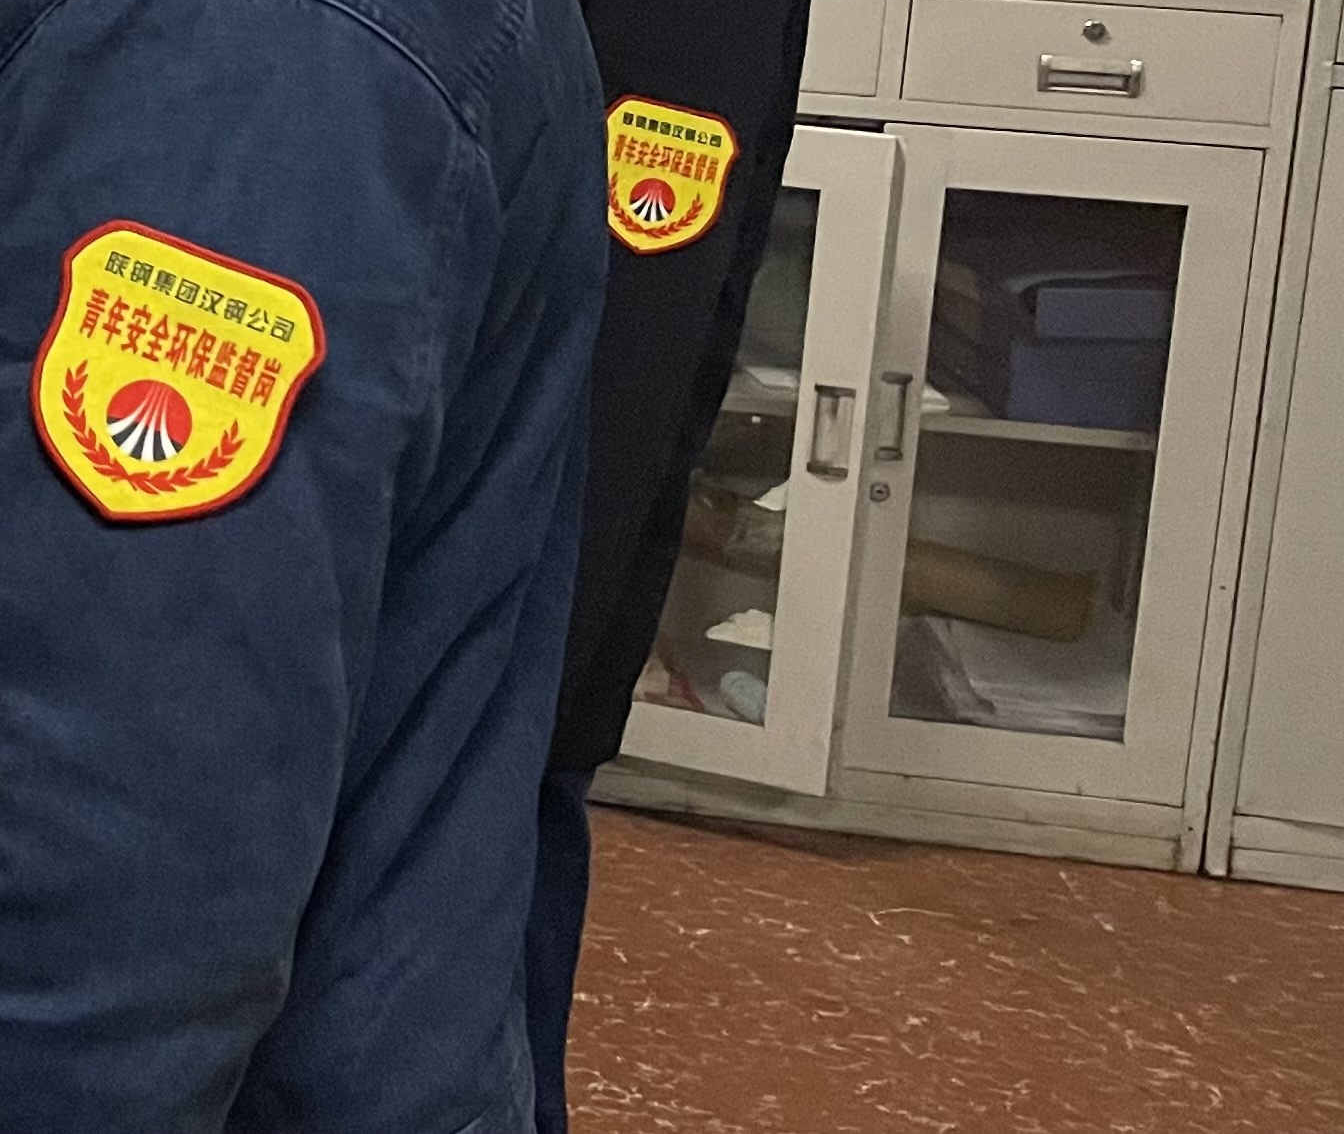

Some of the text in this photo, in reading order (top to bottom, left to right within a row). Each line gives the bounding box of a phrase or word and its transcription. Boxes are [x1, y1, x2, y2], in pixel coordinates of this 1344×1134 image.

[79, 288, 282, 407] 青年安全环保监督岗
[104, 251, 295, 343] 陕钢集团汉钢公司
